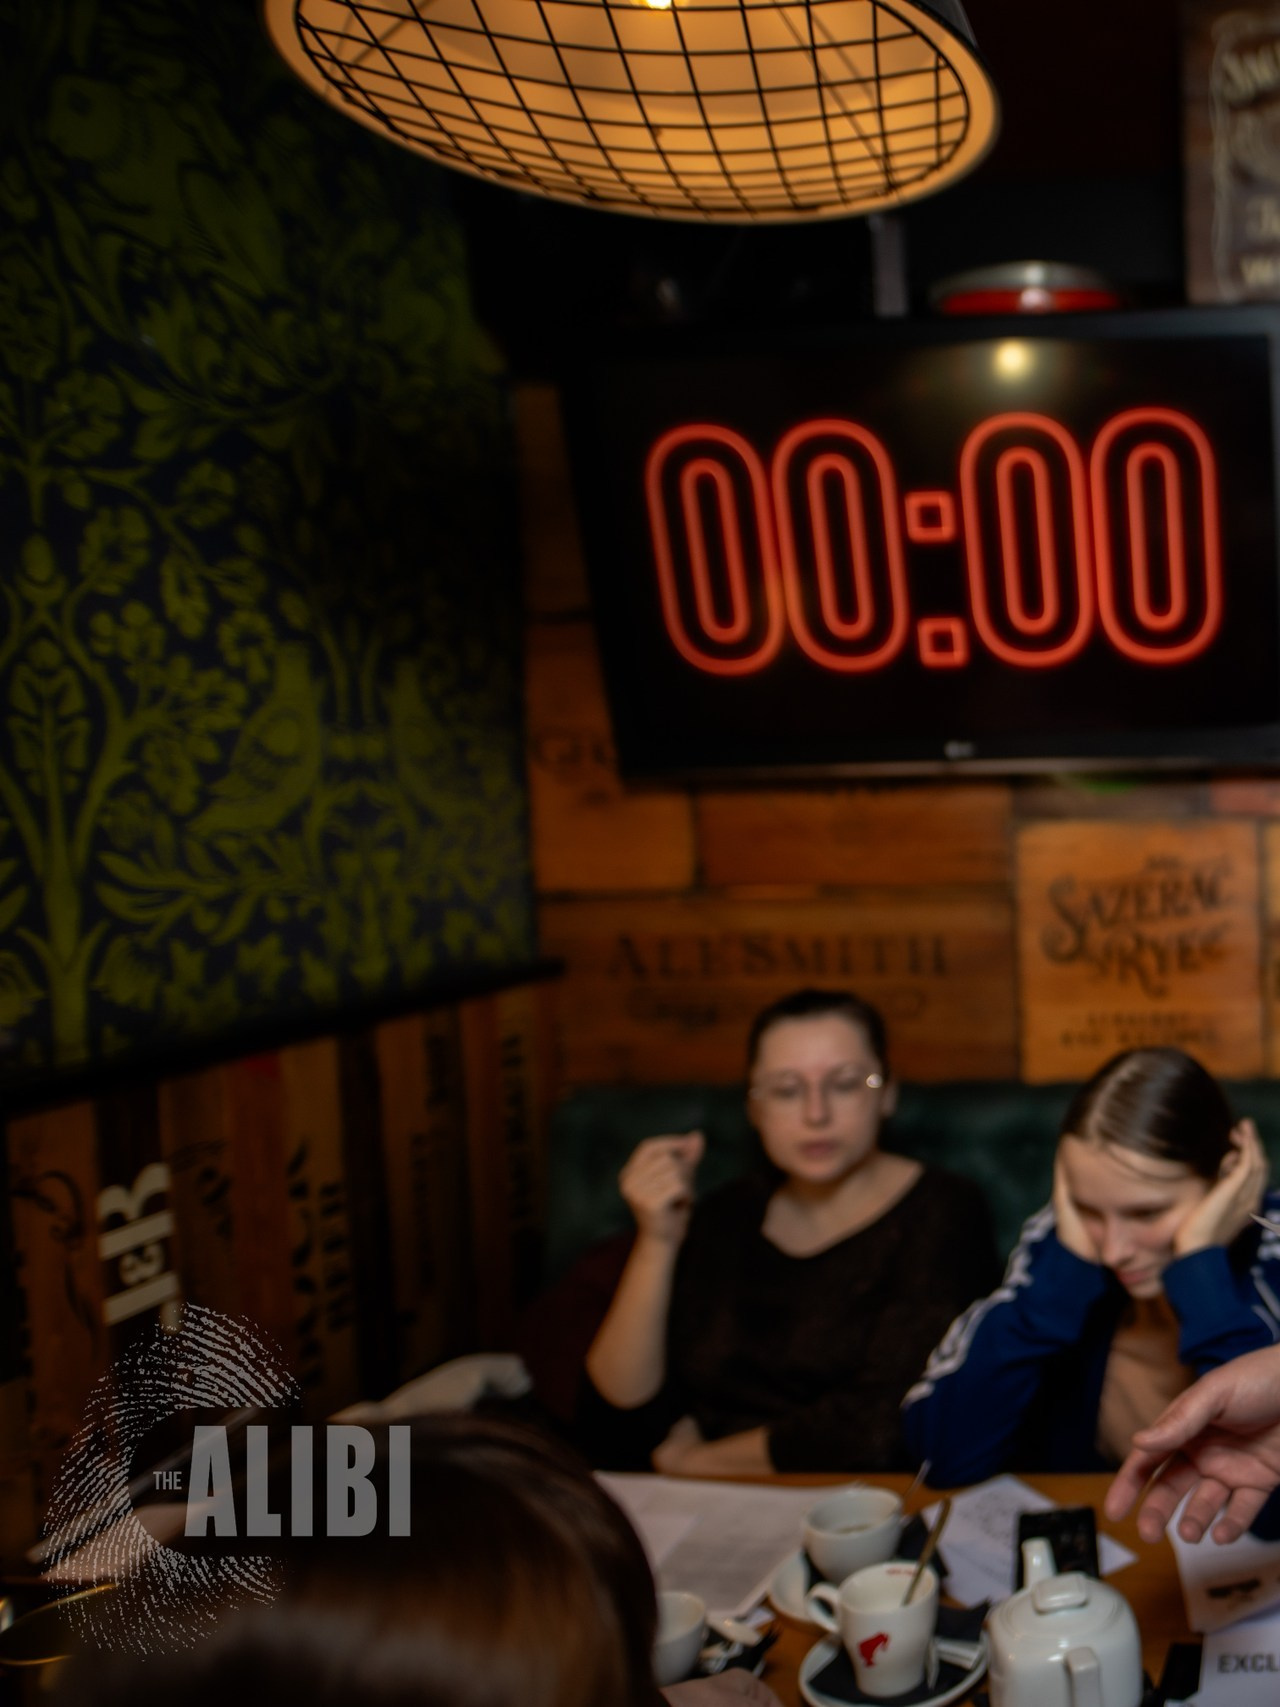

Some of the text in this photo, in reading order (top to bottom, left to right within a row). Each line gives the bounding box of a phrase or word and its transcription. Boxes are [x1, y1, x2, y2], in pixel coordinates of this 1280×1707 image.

[643, 407, 1222, 676] 00:00
[606, 929, 950, 980] ALESMITH
[1040, 853, 1234, 965] SAZERAC
